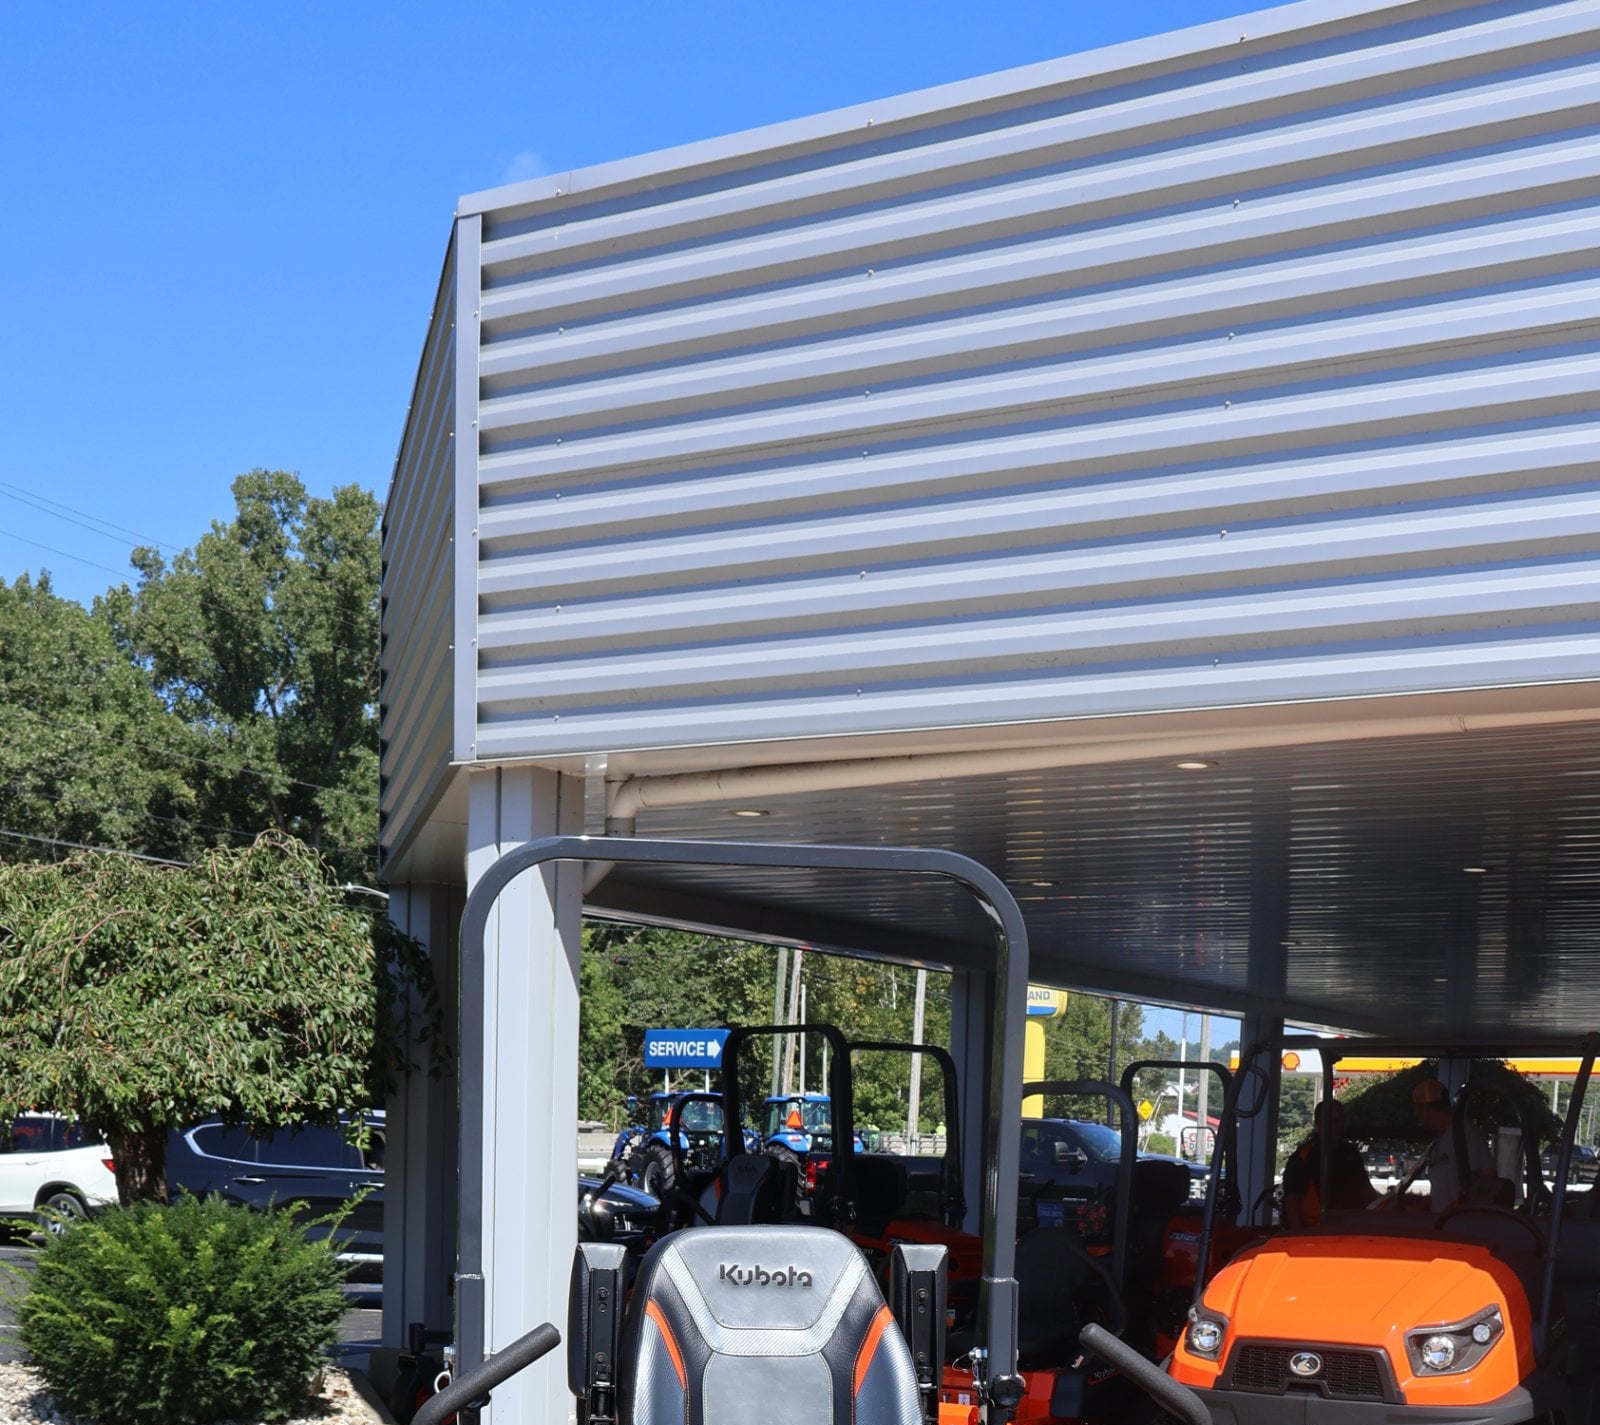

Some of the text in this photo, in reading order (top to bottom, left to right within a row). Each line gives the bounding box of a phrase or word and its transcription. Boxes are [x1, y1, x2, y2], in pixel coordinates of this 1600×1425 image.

[1028, 990, 1050, 1000] AND
[649, 1041, 705, 1056] SERVICE
[719, 1264, 813, 1287] Kubota
